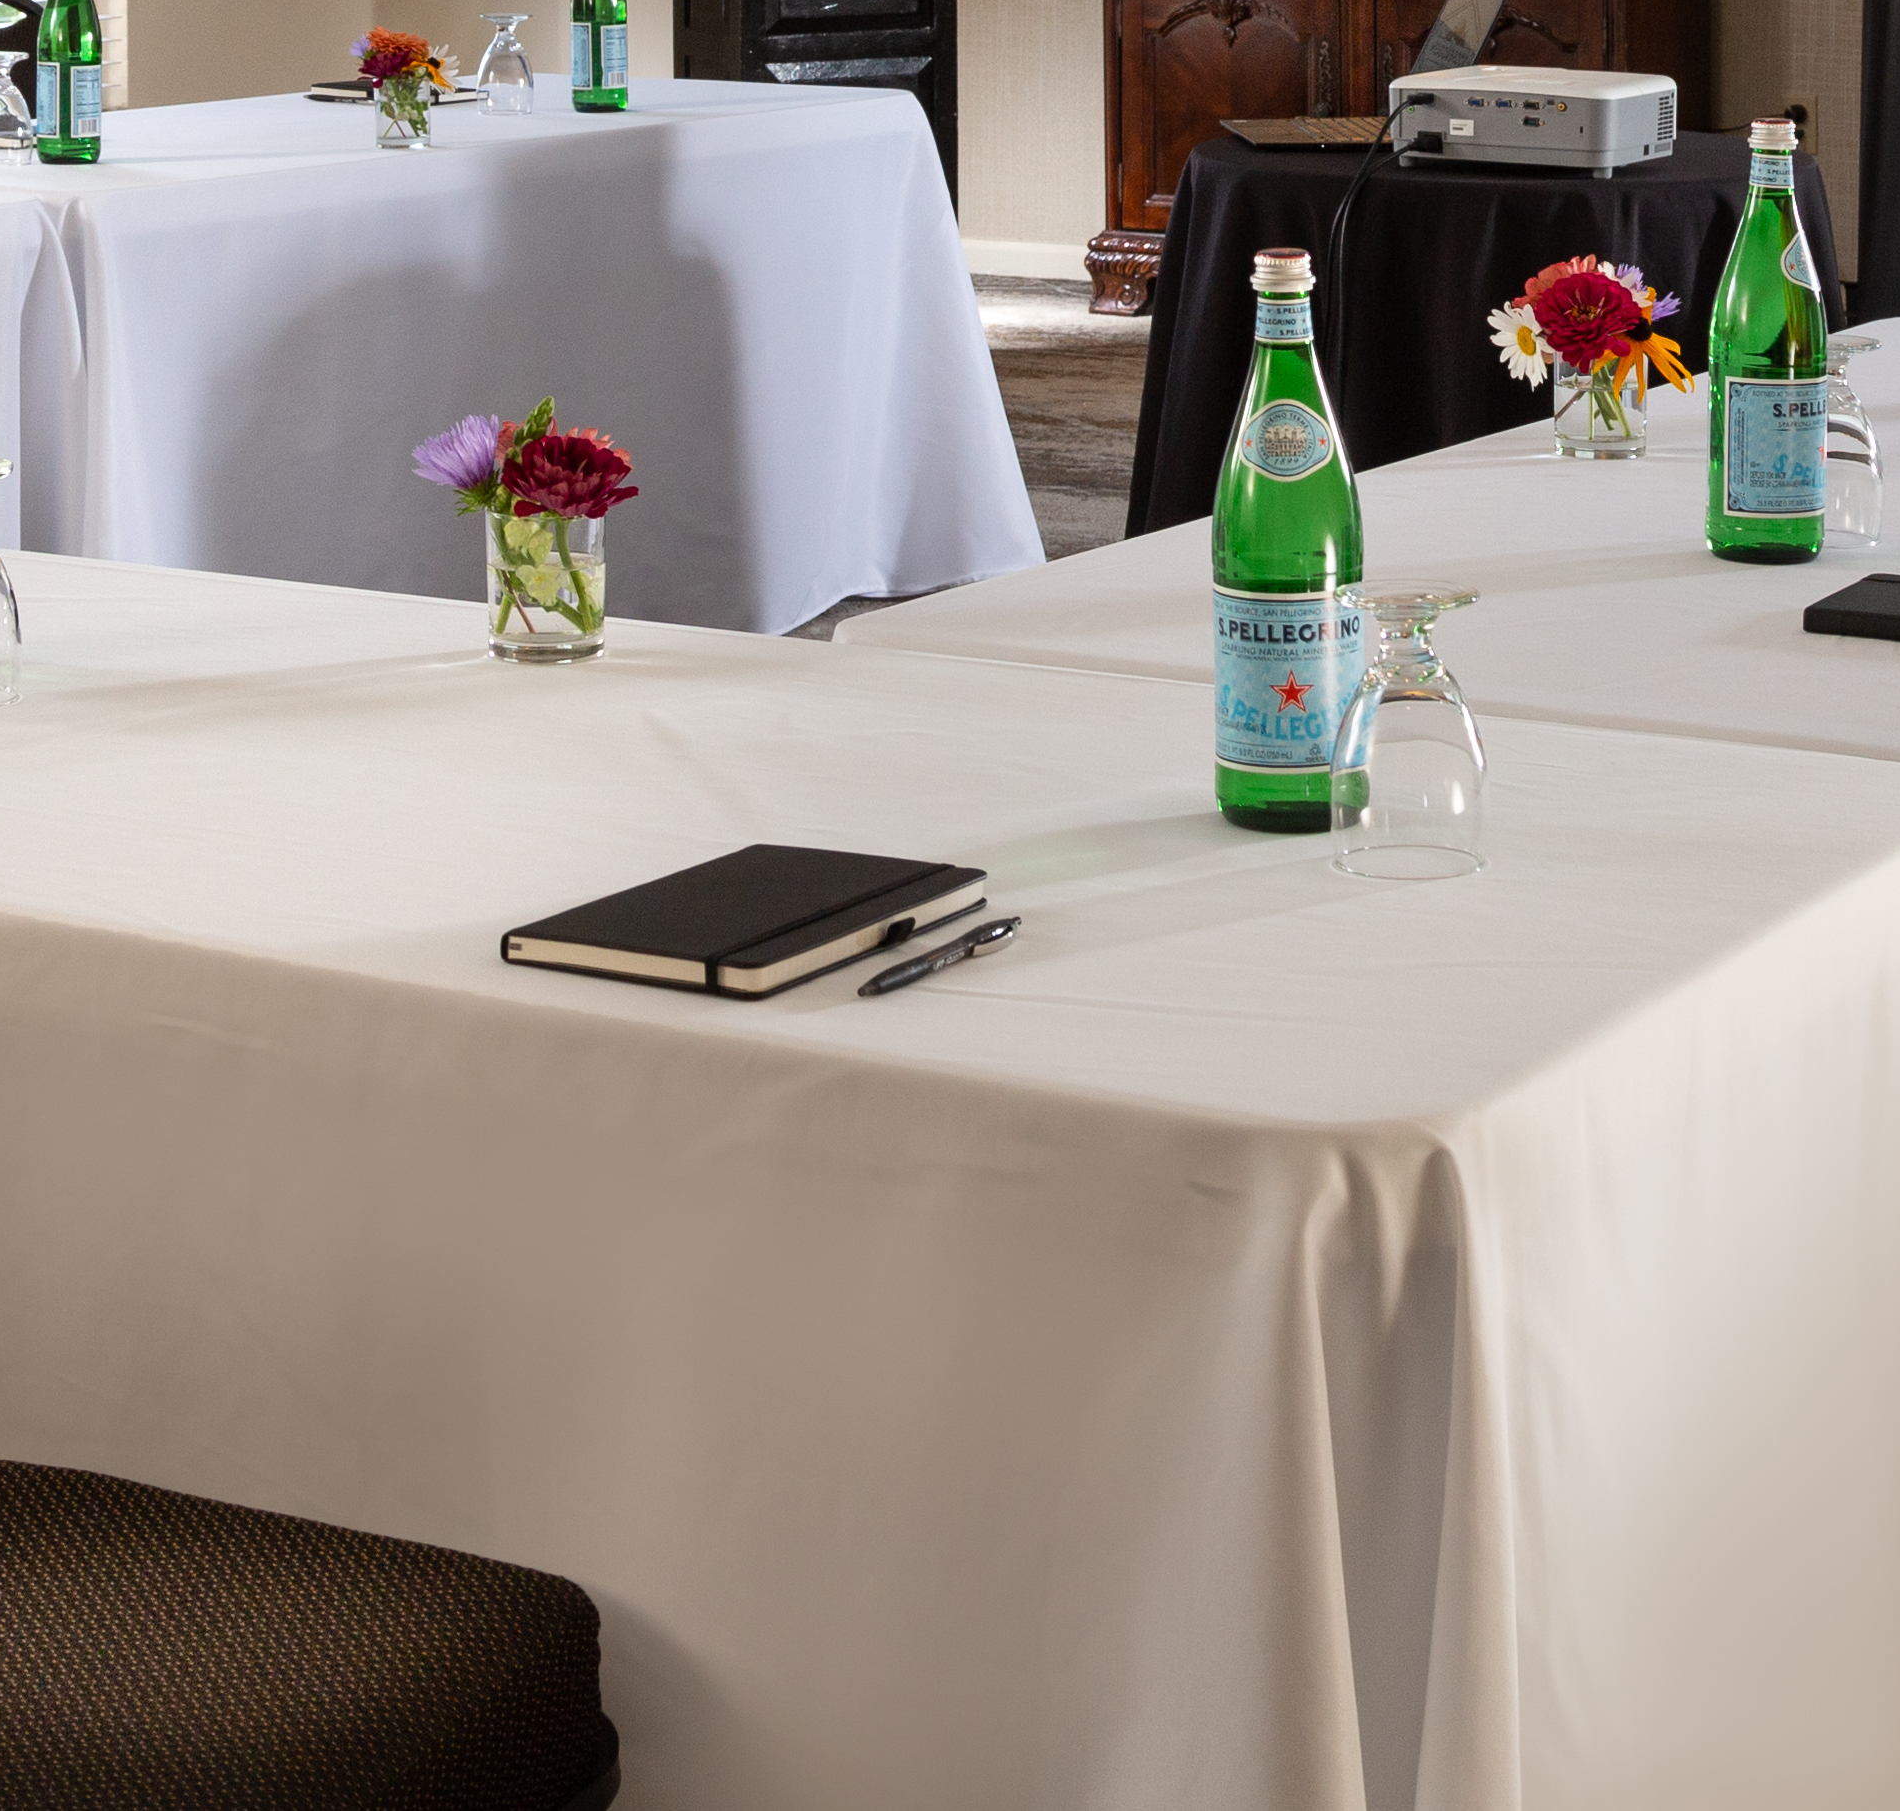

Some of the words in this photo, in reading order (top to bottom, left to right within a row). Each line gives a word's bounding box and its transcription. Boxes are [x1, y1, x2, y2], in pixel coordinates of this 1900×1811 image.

[1262, 608, 1279, 618] SAN
[1218, 615, 1360, 644] S.PELLEGRINO
[1258, 647, 1299, 657] NATURAL
